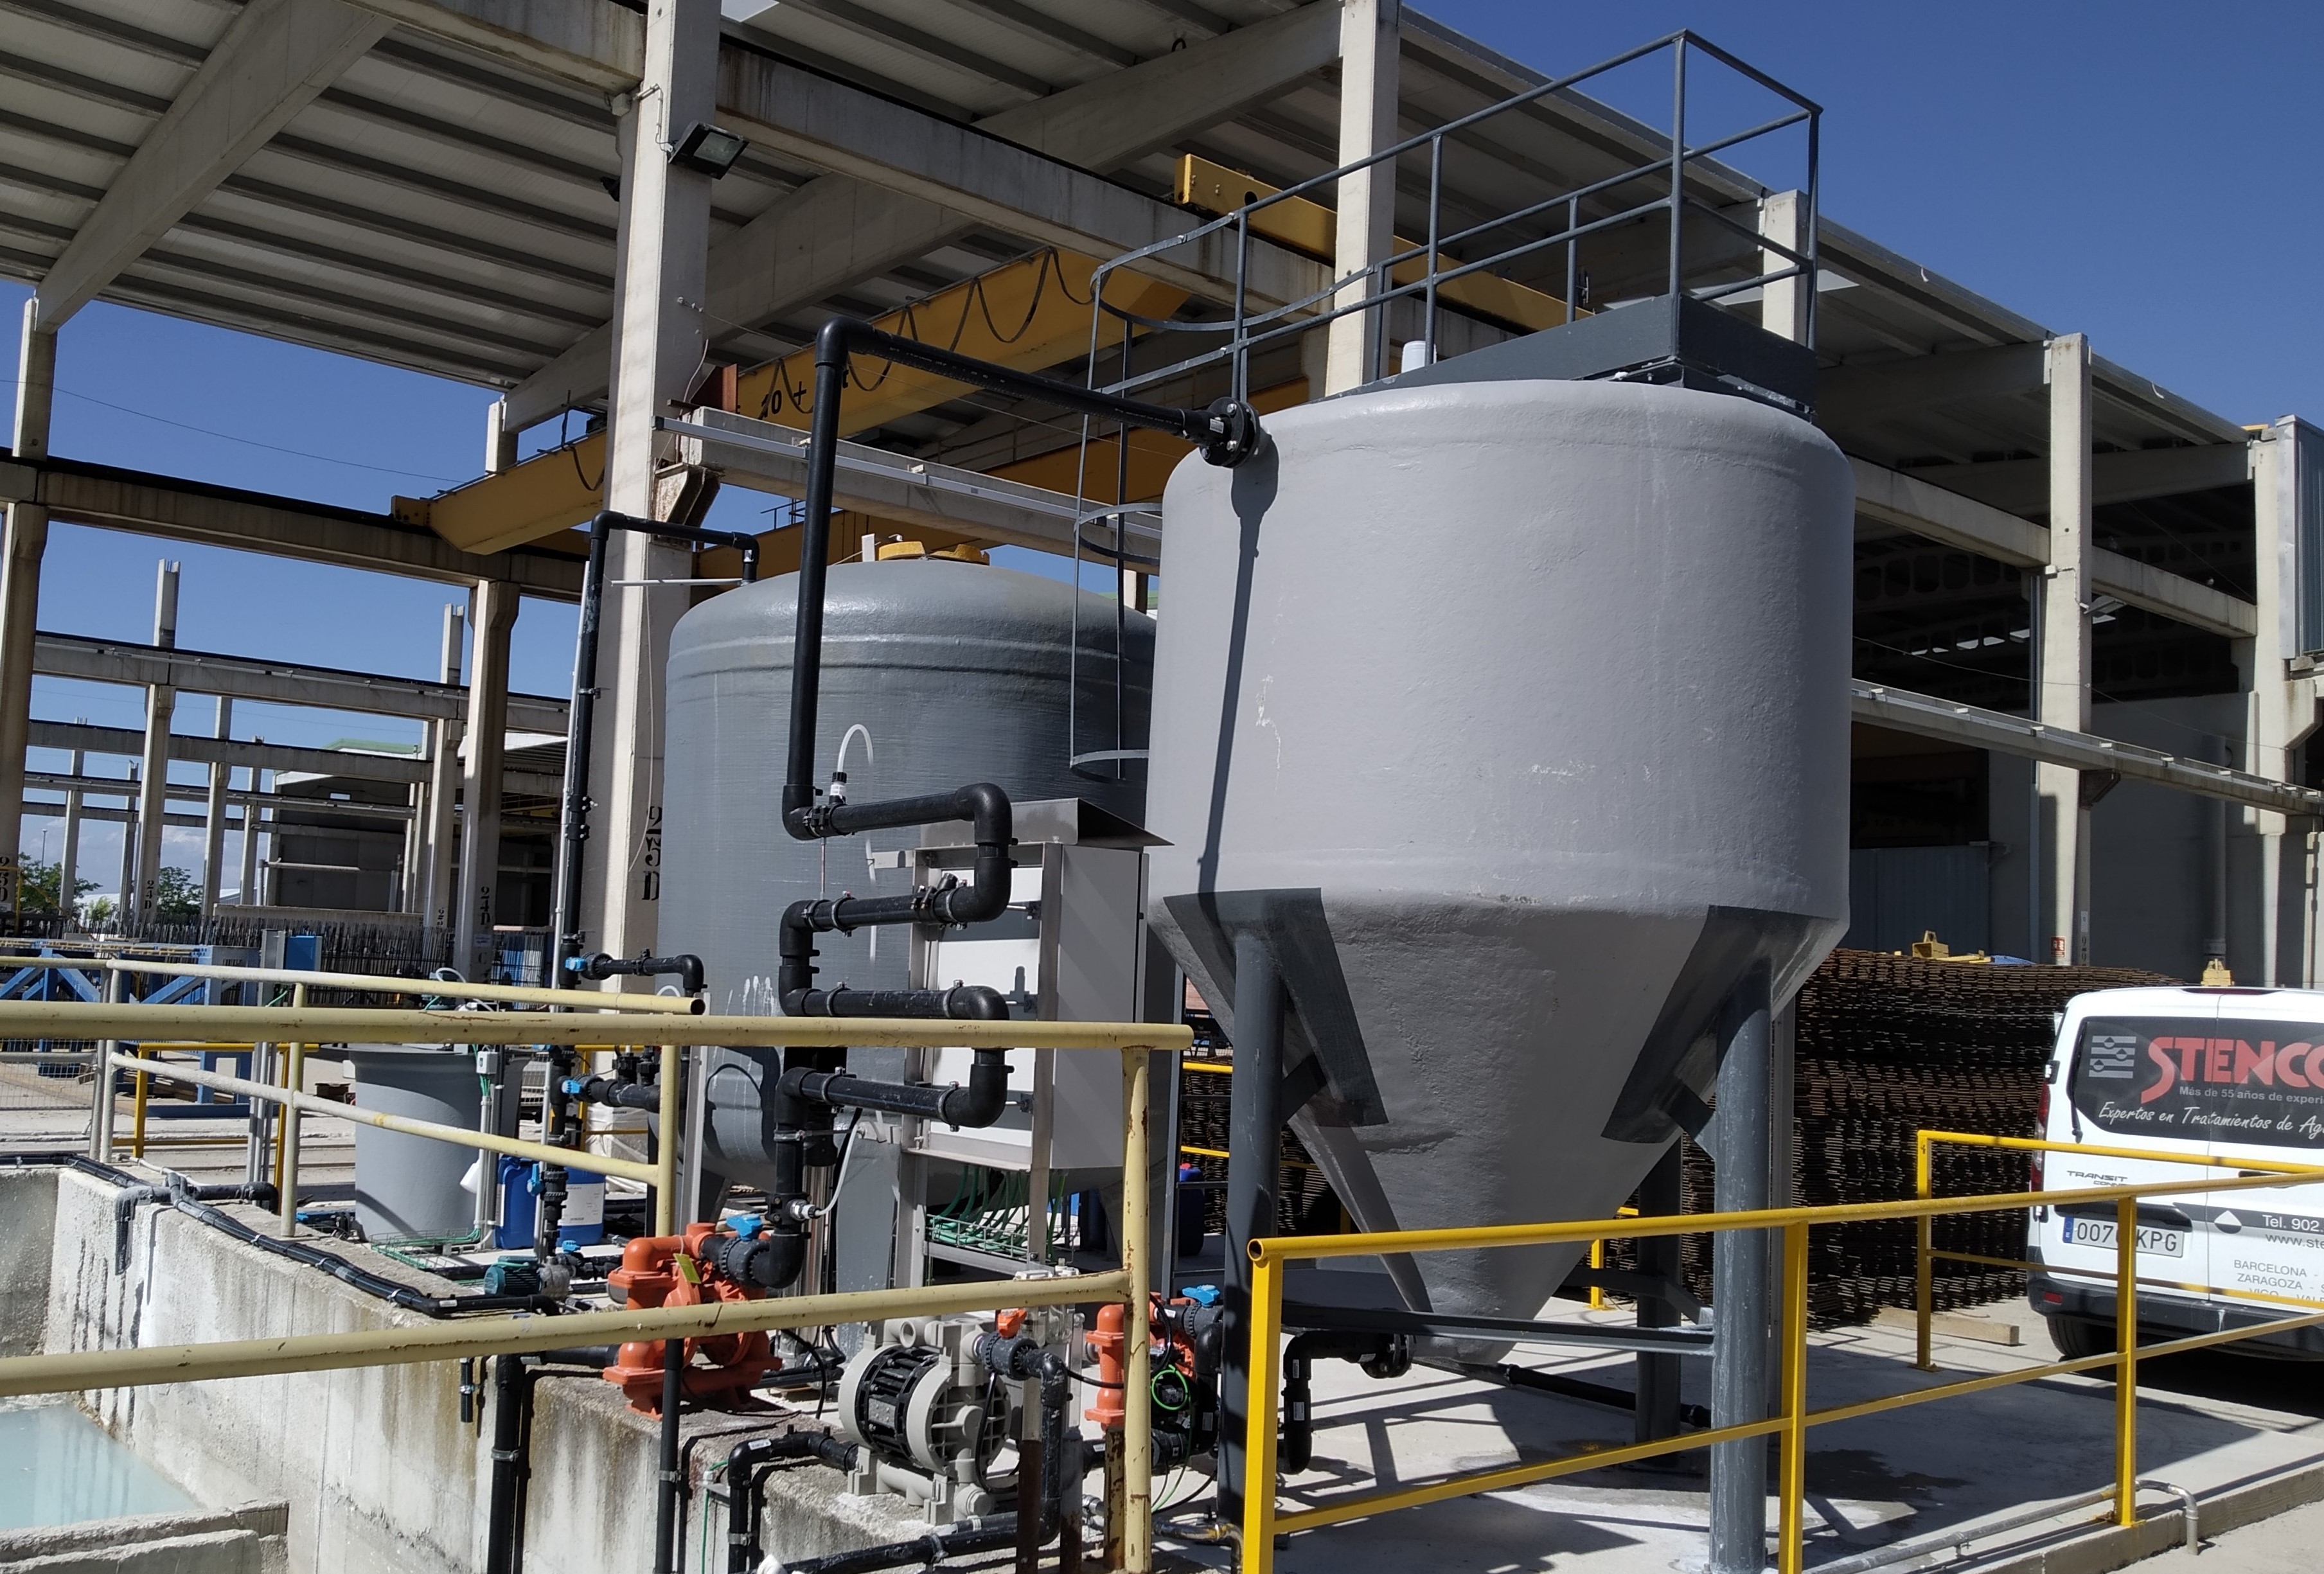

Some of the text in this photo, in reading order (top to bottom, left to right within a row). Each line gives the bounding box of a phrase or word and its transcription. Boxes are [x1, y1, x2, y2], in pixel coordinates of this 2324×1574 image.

[2179, 1086, 2324, 1105] Más de 55 años de experi
[2098, 1101, 2155, 1125] Expertos
[2159, 1111, 2175, 1124] en
[2182, 1106, 2272, 1129] Tratamientos
[2276, 1115, 2293, 1131] de
[2066, 1170, 2128, 1182] TRANSIT
[2262, 1214, 2287, 1228] Tel.
[2077, 1222, 2177, 1251] 007 KPG
[2234, 1259, 2307, 1277] BARCELONA
[2237, 1273, 2303, 1289] ZARAGOZA
